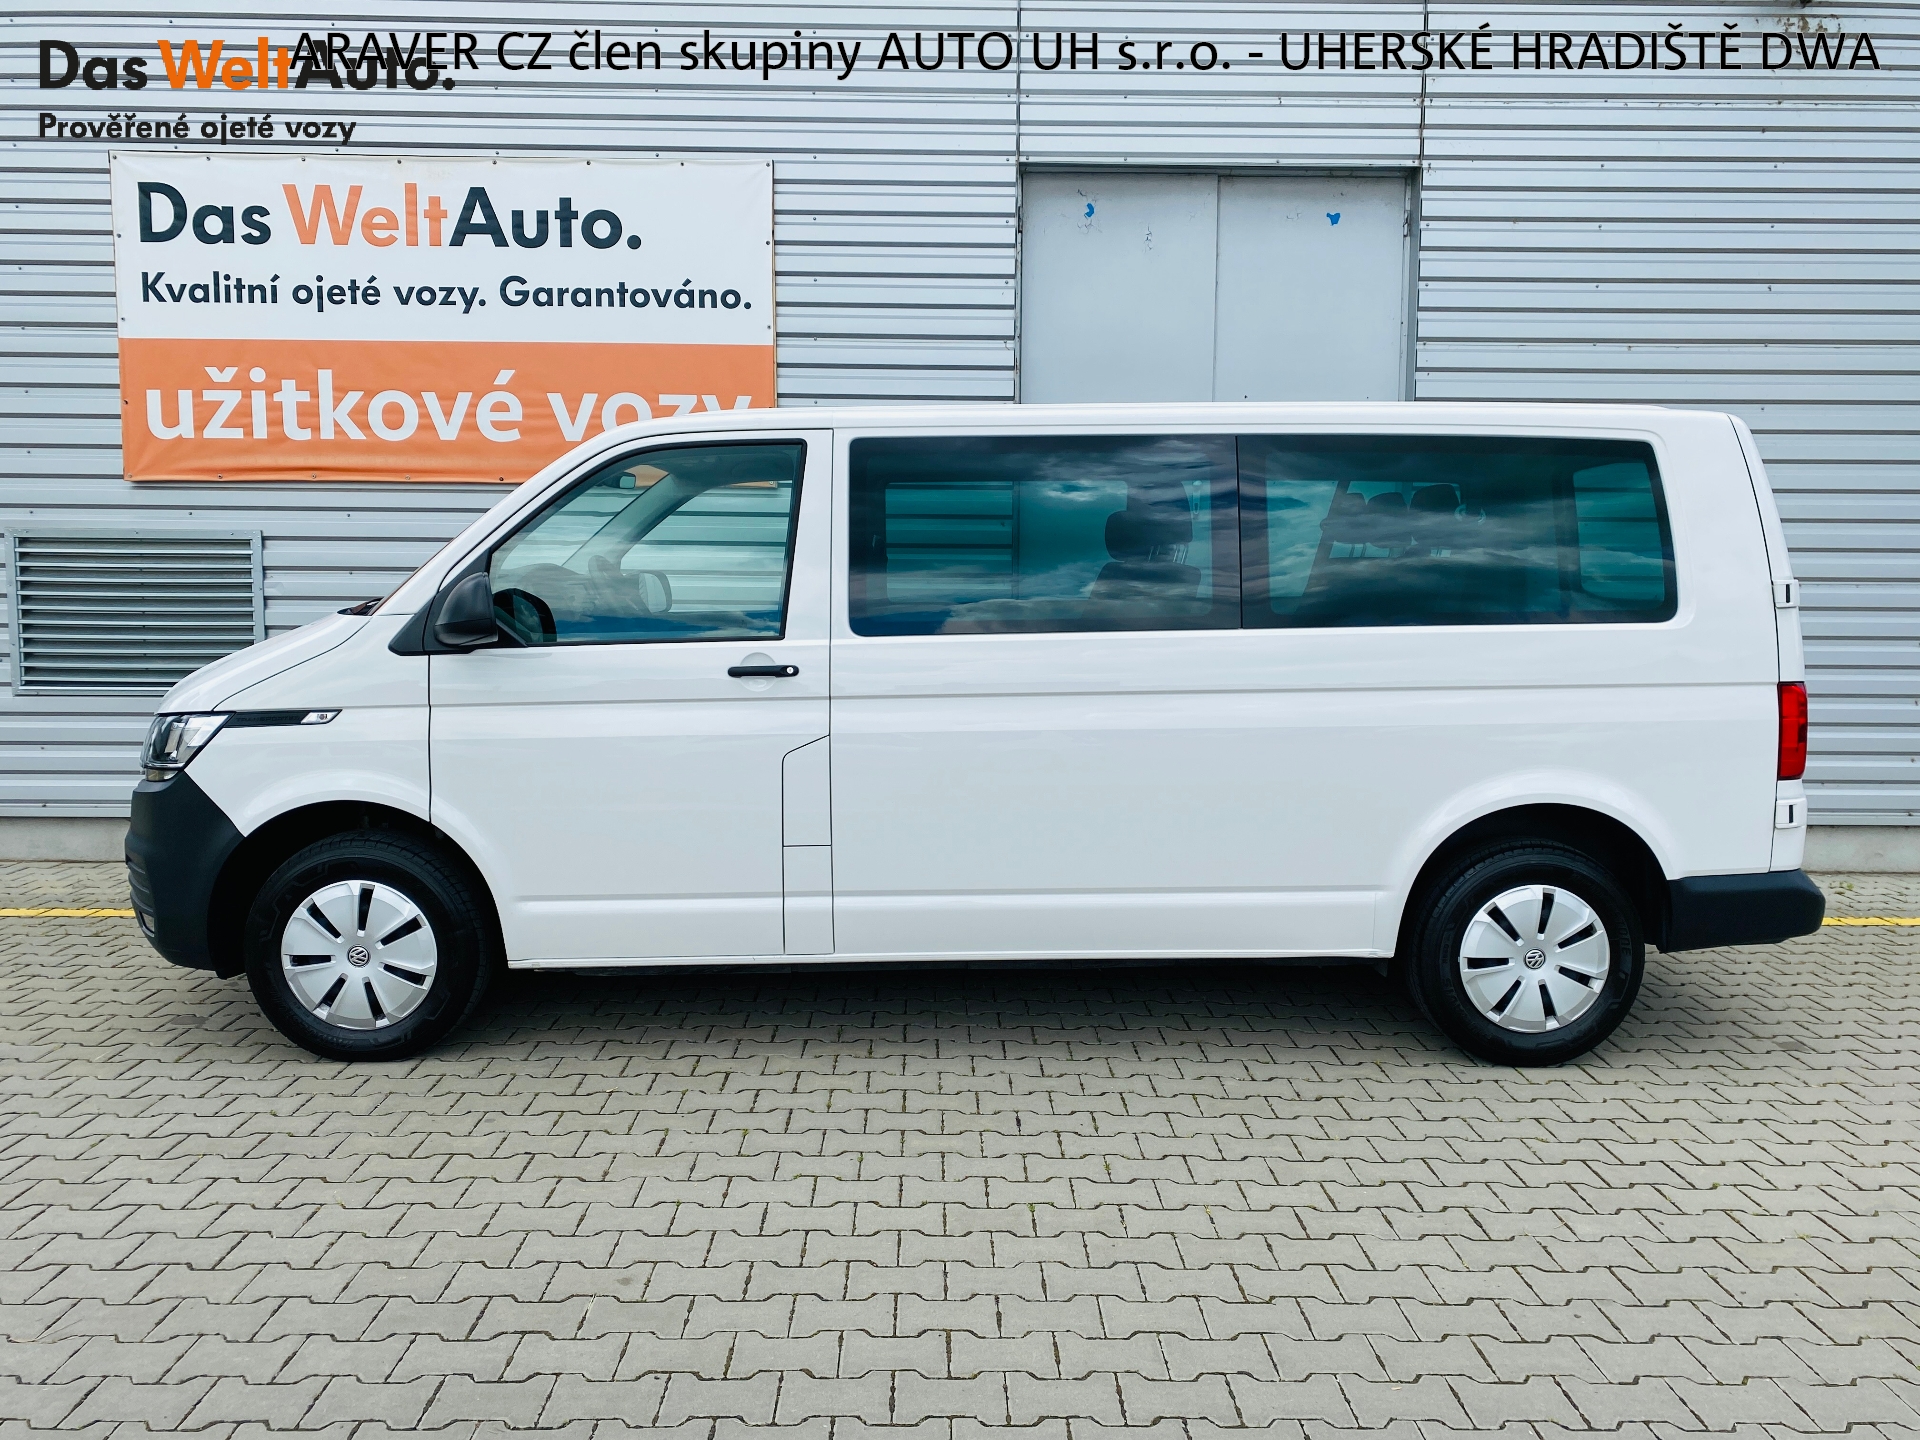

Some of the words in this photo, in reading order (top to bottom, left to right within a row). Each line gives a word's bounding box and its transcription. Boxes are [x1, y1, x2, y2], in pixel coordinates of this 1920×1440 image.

[137, 182, 271, 245] Das
[283, 183, 642, 250] WeltAuto.
[141, 271, 280, 305] Kvalitní
[292, 275, 381, 313] ojeté
[392, 285, 487, 314] vozy.
[499, 276, 752, 310] Garantováno.
[146, 366, 523, 442] užitkové
